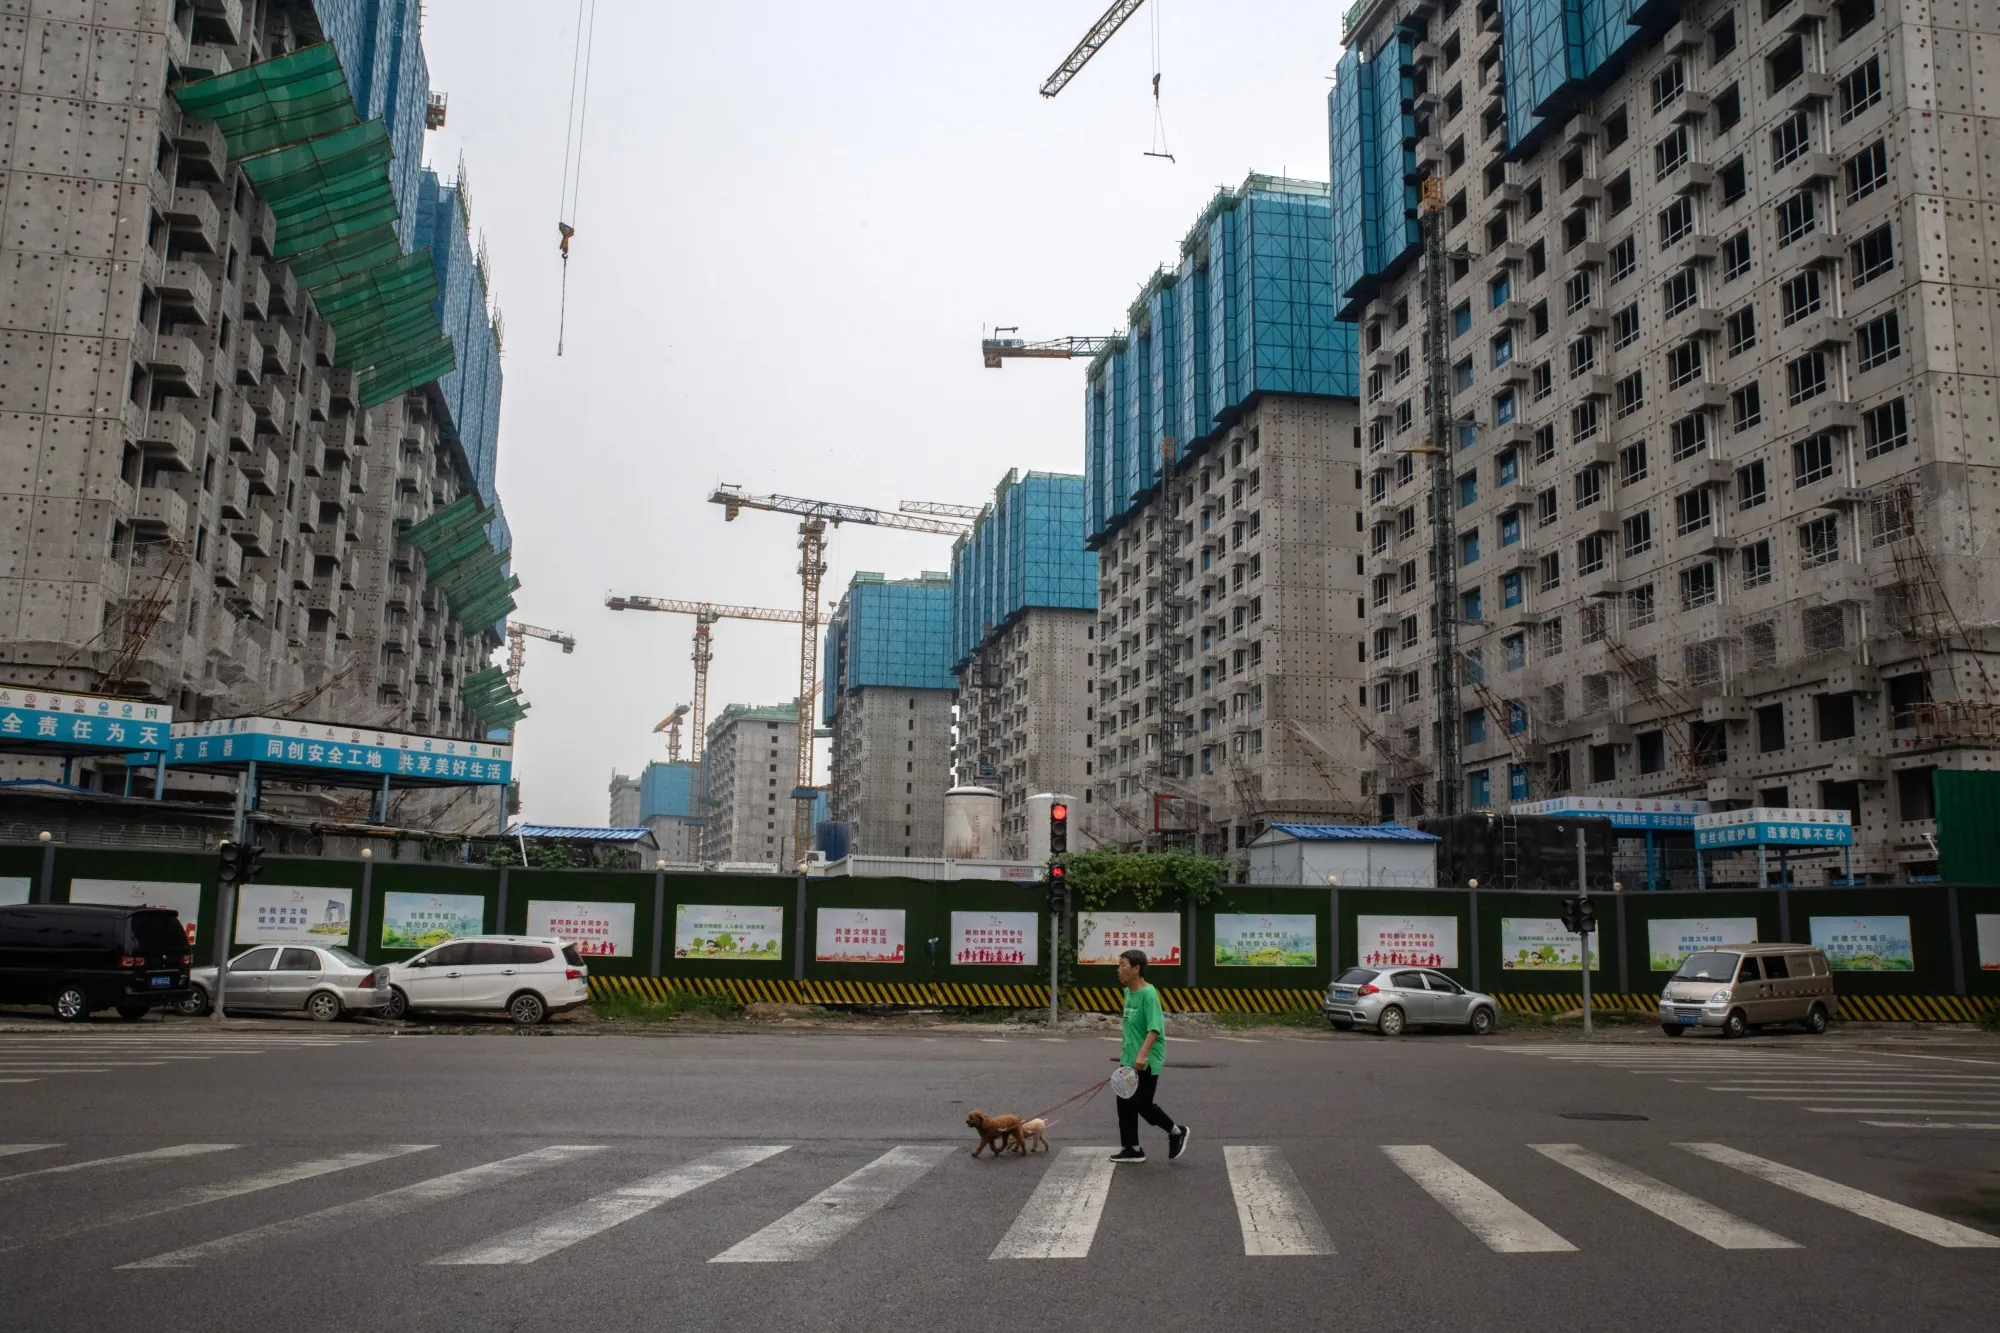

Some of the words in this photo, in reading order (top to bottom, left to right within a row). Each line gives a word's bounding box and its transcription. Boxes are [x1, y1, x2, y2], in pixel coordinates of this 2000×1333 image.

[1, 712, 158, 745] 全责任为天
[267, 739, 383, 769] 同创安全工地
[399, 753, 502, 780] 共享美好生活
[1766, 826, 1847, 842] 违章的事不在小
[258, 906, 308, 915] 你我共文明
[410, 912, 457, 920] 创建文明城区
[257, 916, 307, 925] 城市更精彩
[550, 919, 610, 927] 朝阳群众共同参与
[835, 928, 887, 936] 共建文明城区
[1104, 931, 1155, 939] 共建文明城区
[1379, 932, 1435, 940] 朝阳群众共同参与
[835, 936, 887, 945] 共享美好生活
[1831, 934, 1888, 942] 创建文明城区
[1104, 939, 1155, 947] 共享美好生活
